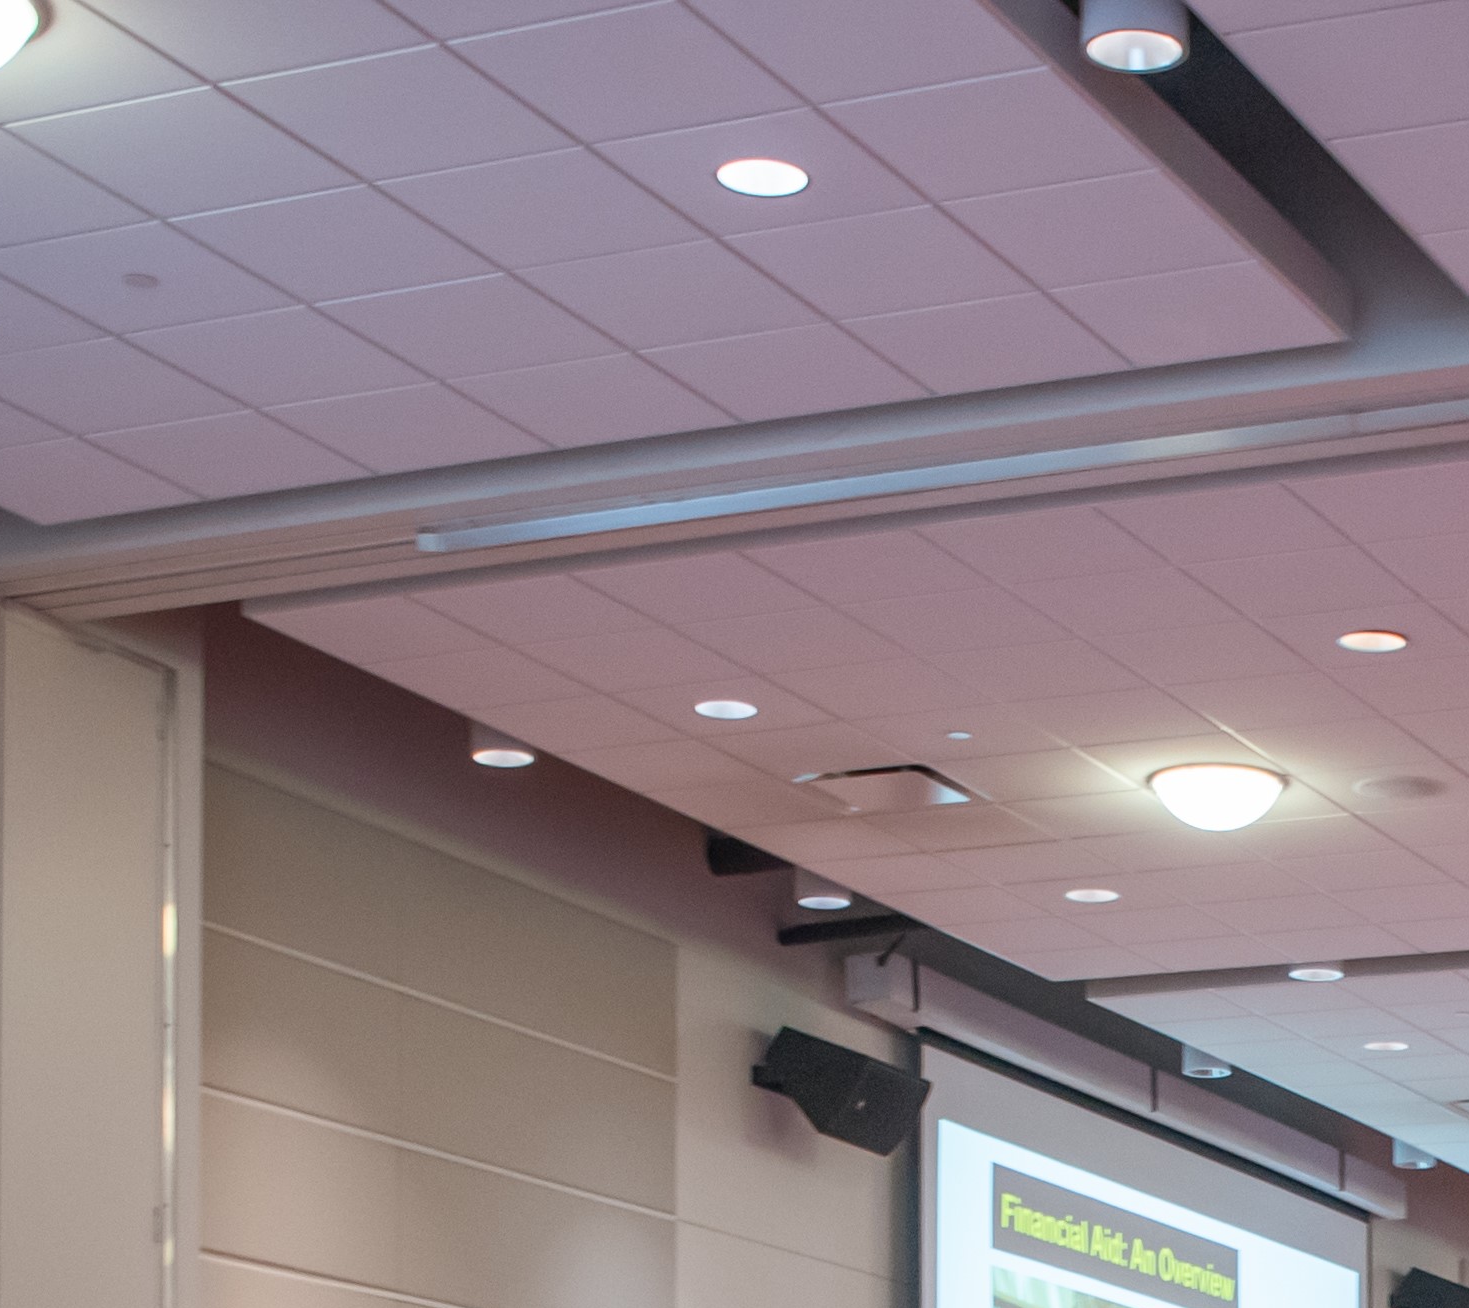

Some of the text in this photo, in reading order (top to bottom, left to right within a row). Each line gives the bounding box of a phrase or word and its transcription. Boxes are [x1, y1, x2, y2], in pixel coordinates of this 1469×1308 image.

[1000, 1192, 1235, 1302] Financial Aid: An Overview
